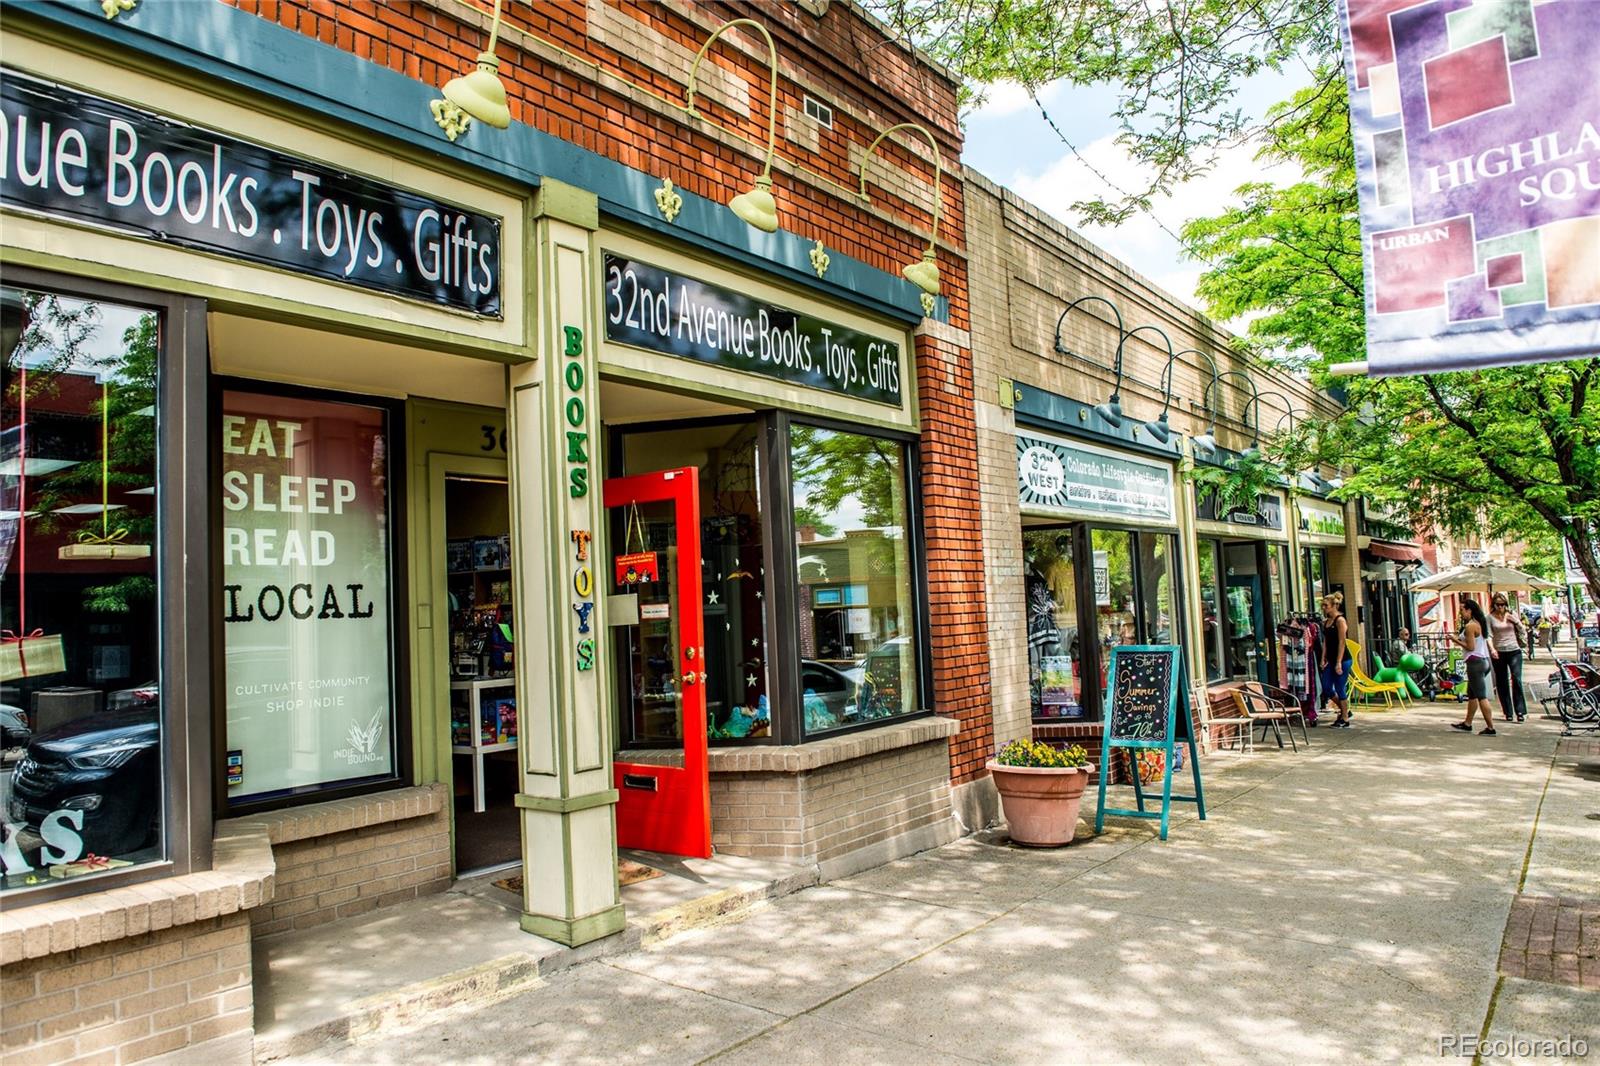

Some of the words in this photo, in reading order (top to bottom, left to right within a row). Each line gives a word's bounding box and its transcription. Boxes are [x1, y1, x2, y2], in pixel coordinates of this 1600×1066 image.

[106, 118, 259, 239] Books
[292, 169, 384, 276] Toys
[414, 207, 493, 295] Gifts
[1379, 225, 1451, 251] URBAN
[609, 264, 671, 337] 32nd
[677, 284, 755, 359] Avenue
[759, 308, 812, 374] Books
[821, 327, 857, 389] Toys
[867, 342, 899, 394] Gifts
[563, 325, 588, 498] BOOKS
[223, 415, 301, 459] EAT
[1028, 472, 1059, 490] WEST
[1066, 456, 1101, 478] Colorado
[223, 470, 357, 515] SLEEP
[223, 527, 336, 567] READ
[224, 583, 374, 623] LOCAL
[571, 528, 596, 672] TOYS
[1134, 653, 1157, 668] Start
[235, 680, 304, 696] CULTIVATE
[308, 676, 371, 690] COMMUNITY
[1117, 669, 1158, 700] Summer
[266, 698, 305, 713] SHOP
[308, 696, 345, 709] INDIE
[1123, 697, 1157, 713] Savings
